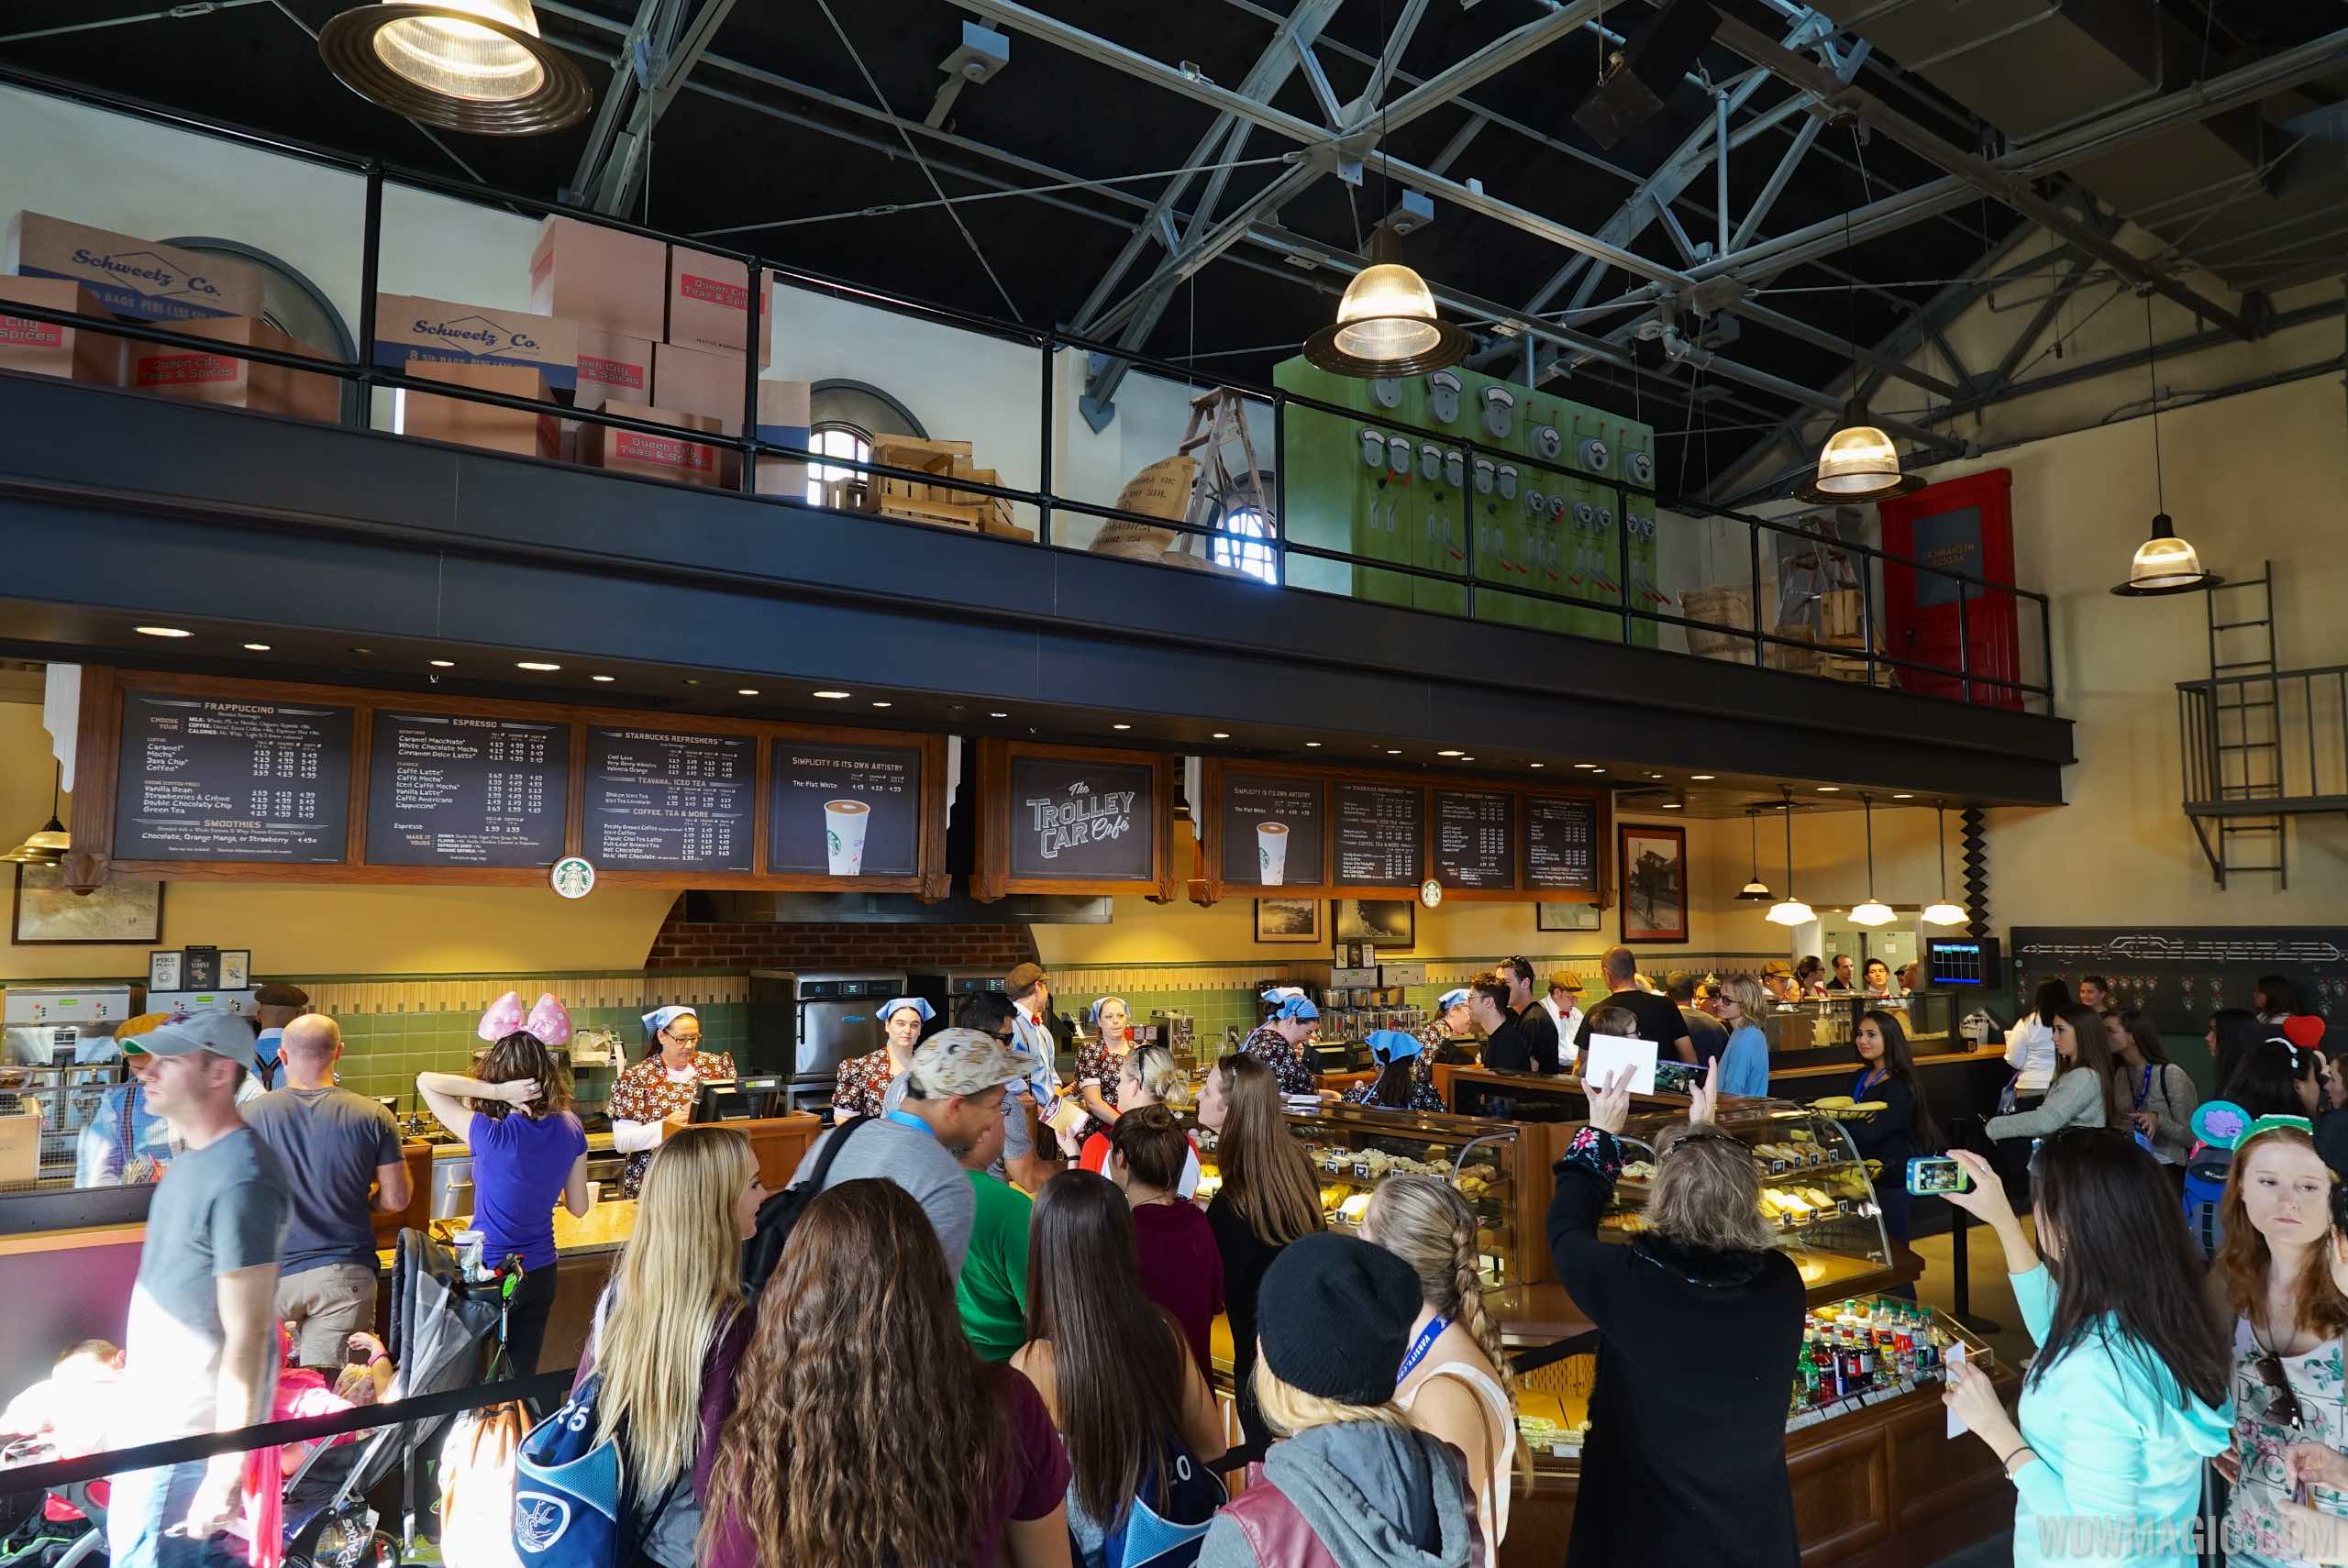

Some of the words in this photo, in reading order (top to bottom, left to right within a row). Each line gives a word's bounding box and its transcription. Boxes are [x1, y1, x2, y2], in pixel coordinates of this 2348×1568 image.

[188, 278, 221, 296] Co.
[695, 279, 728, 293] Queen
[714, 293, 723, 301] &
[511, 334, 540, 349] Co.
[175, 370, 186, 380] &
[190, 366, 235, 379] Spices
[620, 445, 651, 457] Teas
[655, 450, 664, 458] &
[632, 437, 670, 452] Queen
[674, 443, 698, 458] City
[205, 701, 274, 714] FRAPPUCCINO
[452, 719, 497, 728] ESPRESSO
[625, 732, 670, 742] STARBUCKS
[421, 744, 455, 752] Chocolate
[792, 756, 831, 767] SIMPLICITY
[854, 761, 869, 769] OWN
[870, 762, 903, 771] ARTISTRY
[629, 767, 648, 775] Orange
[144, 785, 171, 793] Vanilla
[1069, 781, 1090, 796] The
[1234, 787, 1261, 796] SIMPLICITY
[144, 791, 195, 801] Strawberries
[142, 805, 170, 813] Green
[143, 799, 170, 807] Double
[172, 800, 213, 809] Chocolaty
[215, 801, 233, 810] Chip
[1025, 791, 1135, 831] TROLLEY
[204, 820, 261, 829] SMOOTHIES
[183, 834, 212, 843] Orange
[249, 835, 289, 845] Strawberry
[1041, 823, 1089, 858] CAR
[1091, 815, 1130, 840] Café
